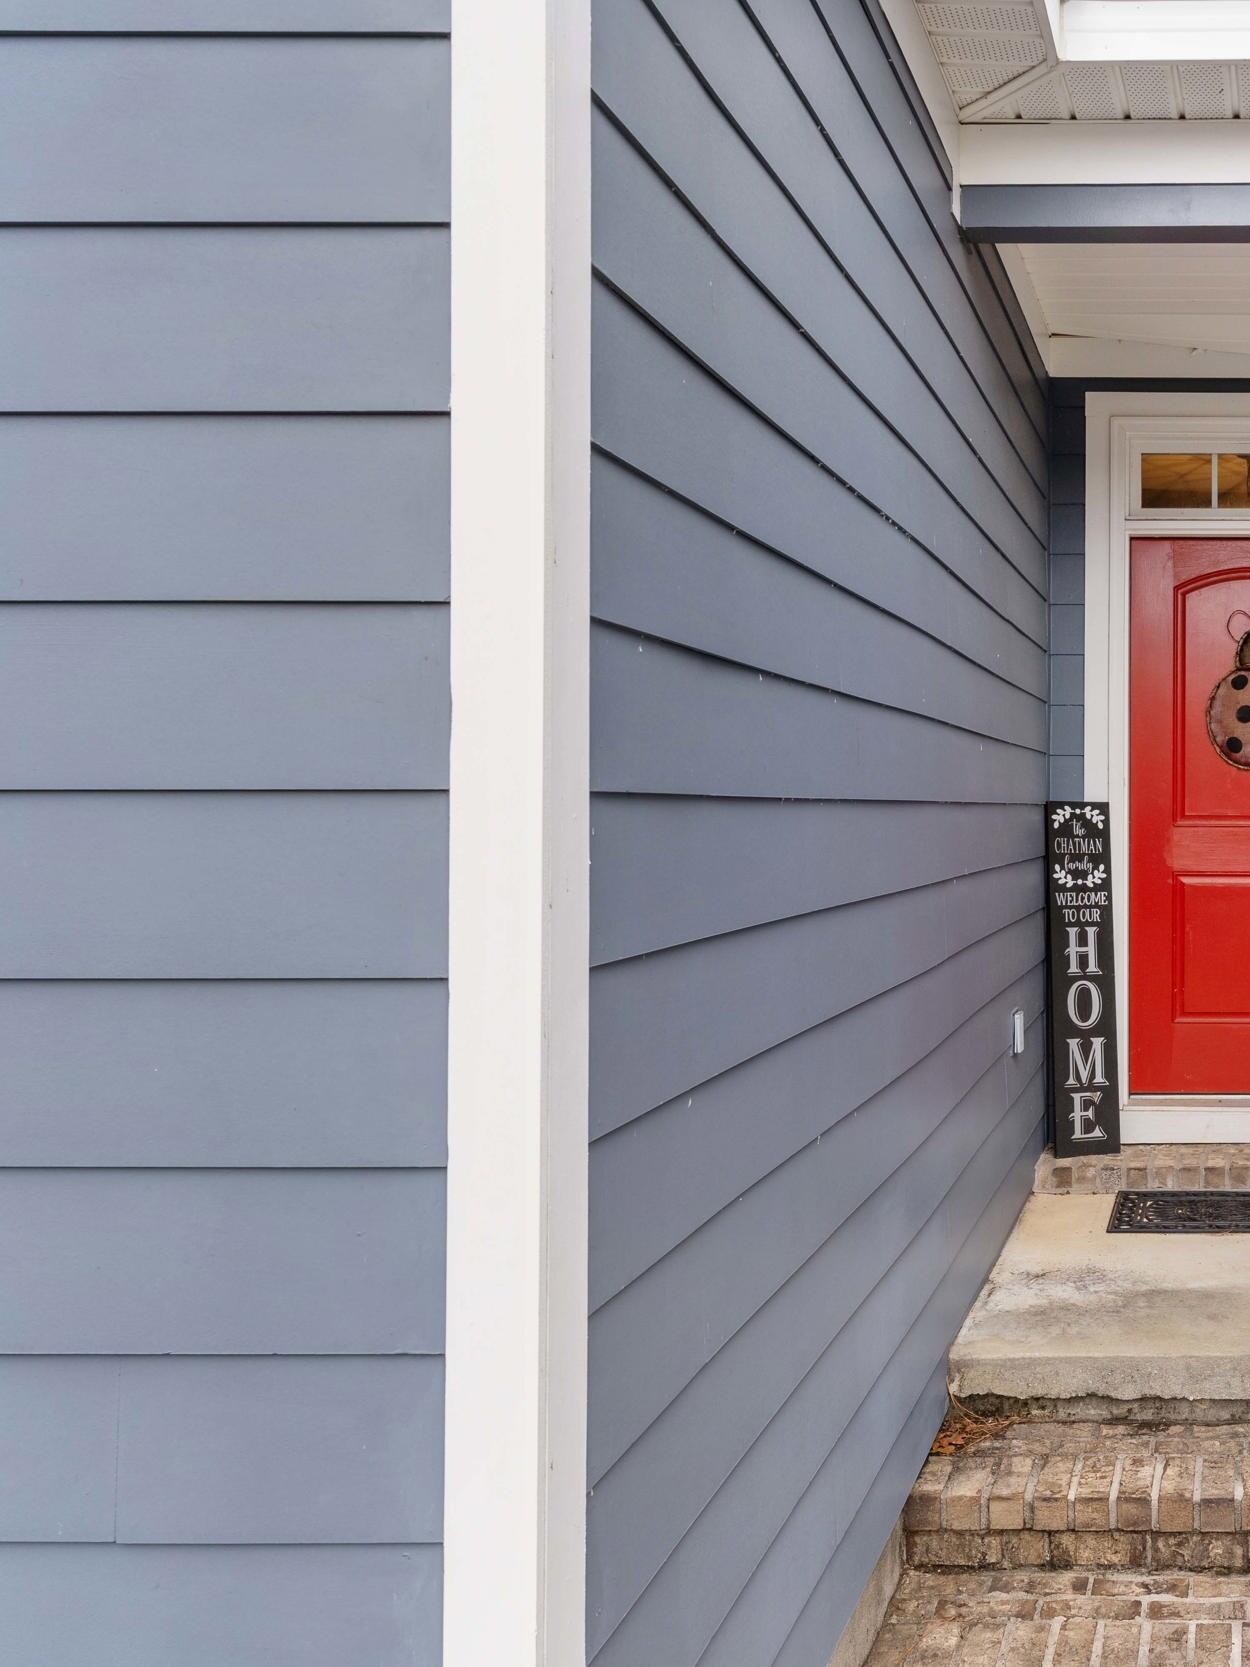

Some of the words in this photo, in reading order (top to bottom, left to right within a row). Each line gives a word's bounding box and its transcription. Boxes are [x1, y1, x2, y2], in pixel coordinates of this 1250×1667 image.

[1068, 818, 1087, 837] the
[1054, 837, 1103, 854] CHATMAN
[1064, 854, 1094, 875] family
[1055, 891, 1109, 906] WELCOME
[1062, 908, 1077, 923] TO
[1080, 908, 1101, 923] OUR
[1063, 926, 1110, 1141] HOME
